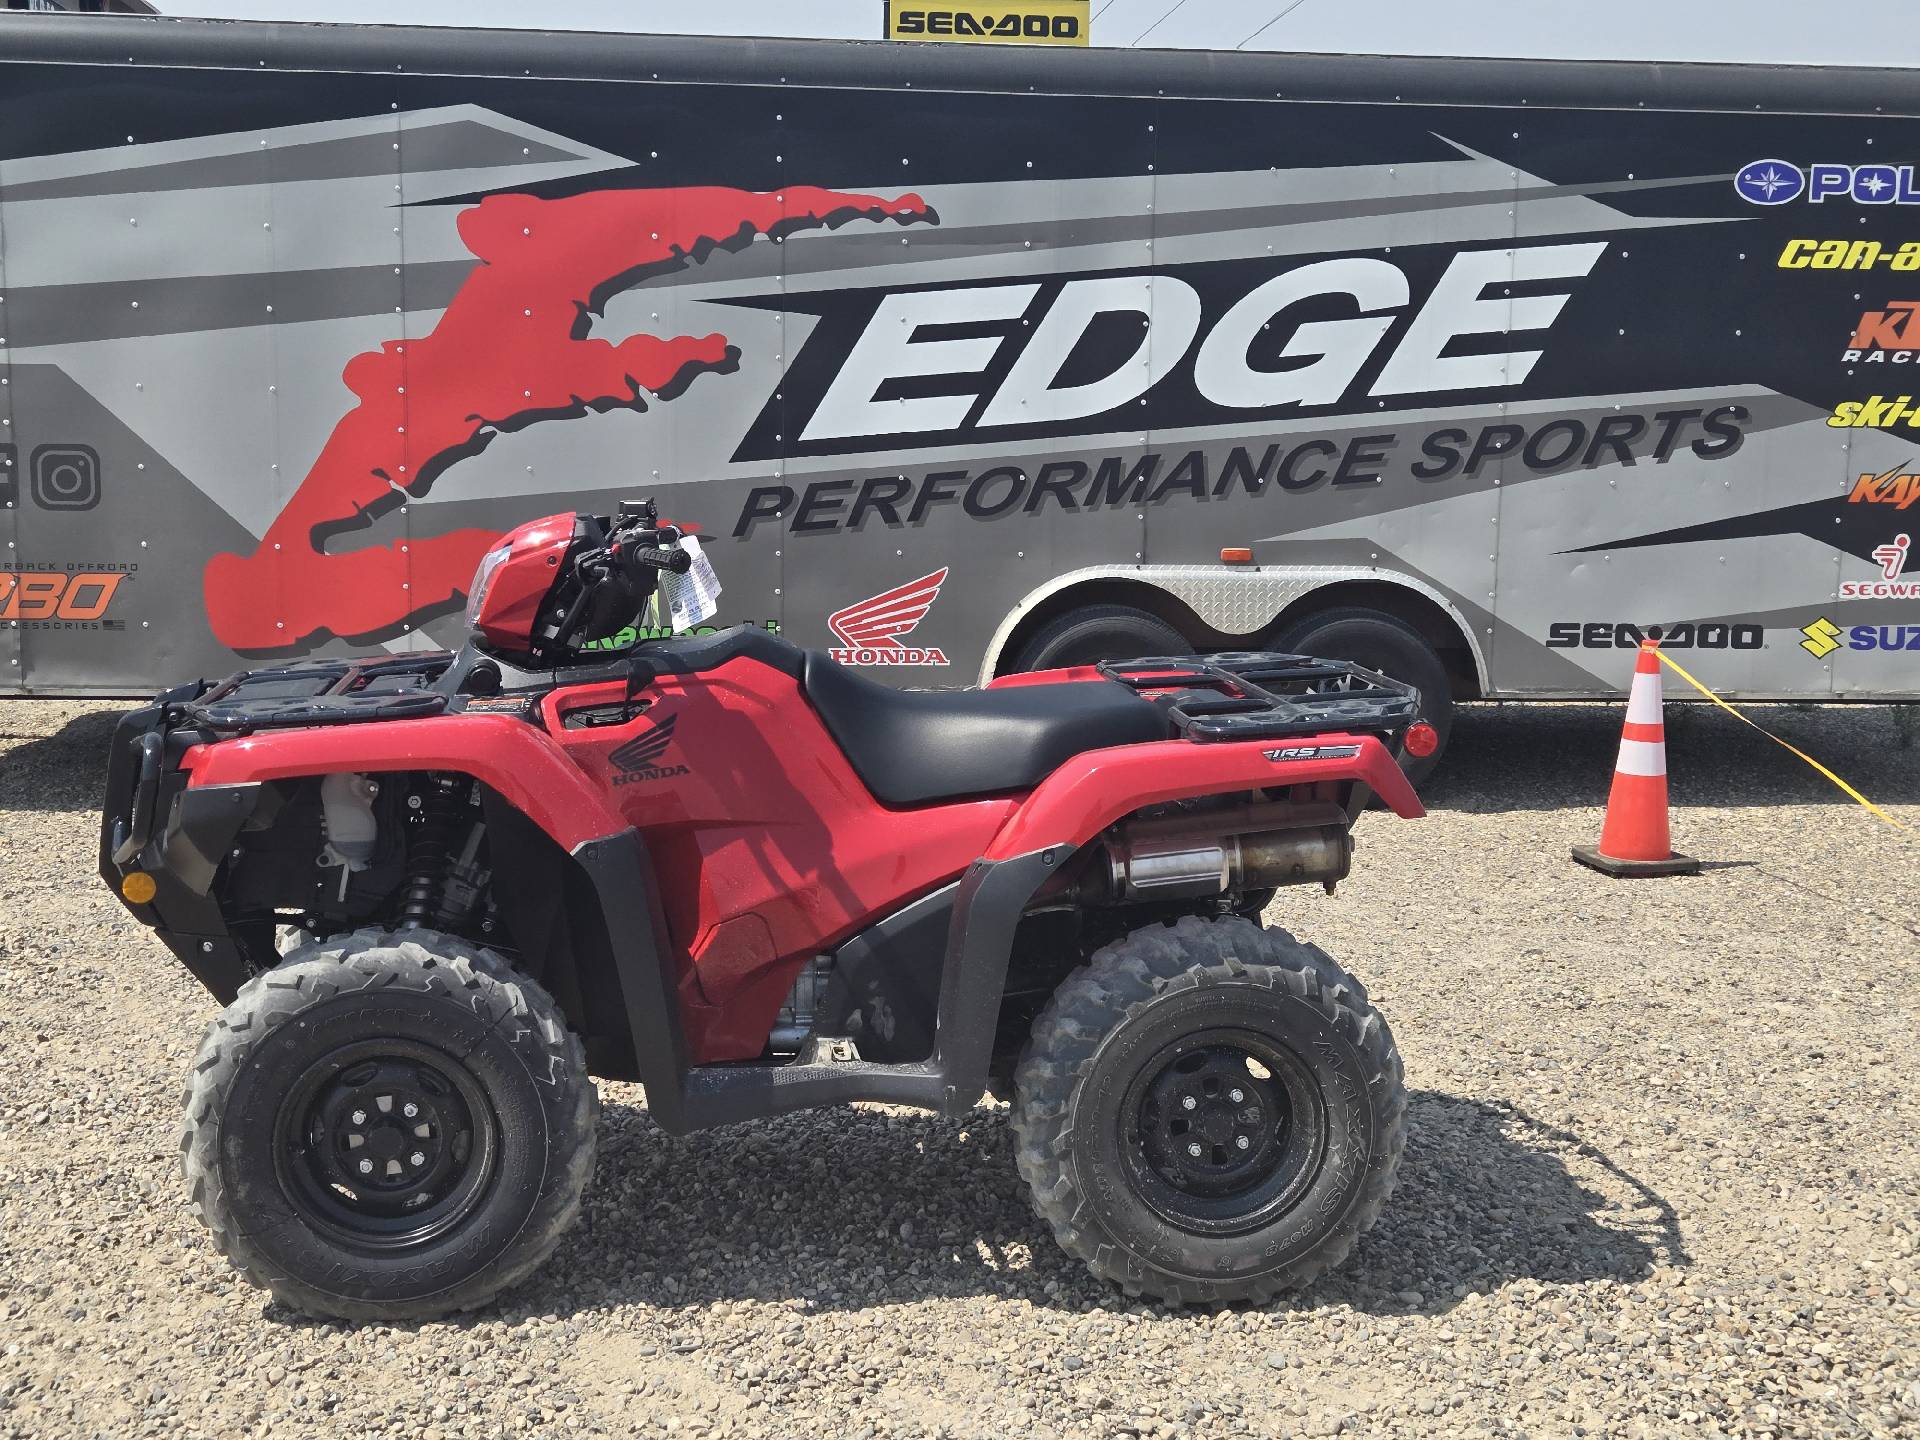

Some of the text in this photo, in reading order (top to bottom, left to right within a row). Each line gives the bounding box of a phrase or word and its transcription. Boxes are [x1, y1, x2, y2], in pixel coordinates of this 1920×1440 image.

[798, 242, 1610, 441] EDGE
[731, 405, 1752, 540] PERFORMANCE SPORTS
[66, 562, 138, 572] OFFROAD
[828, 647, 950, 666] HONDA
[611, 764, 690, 786] HONDA
